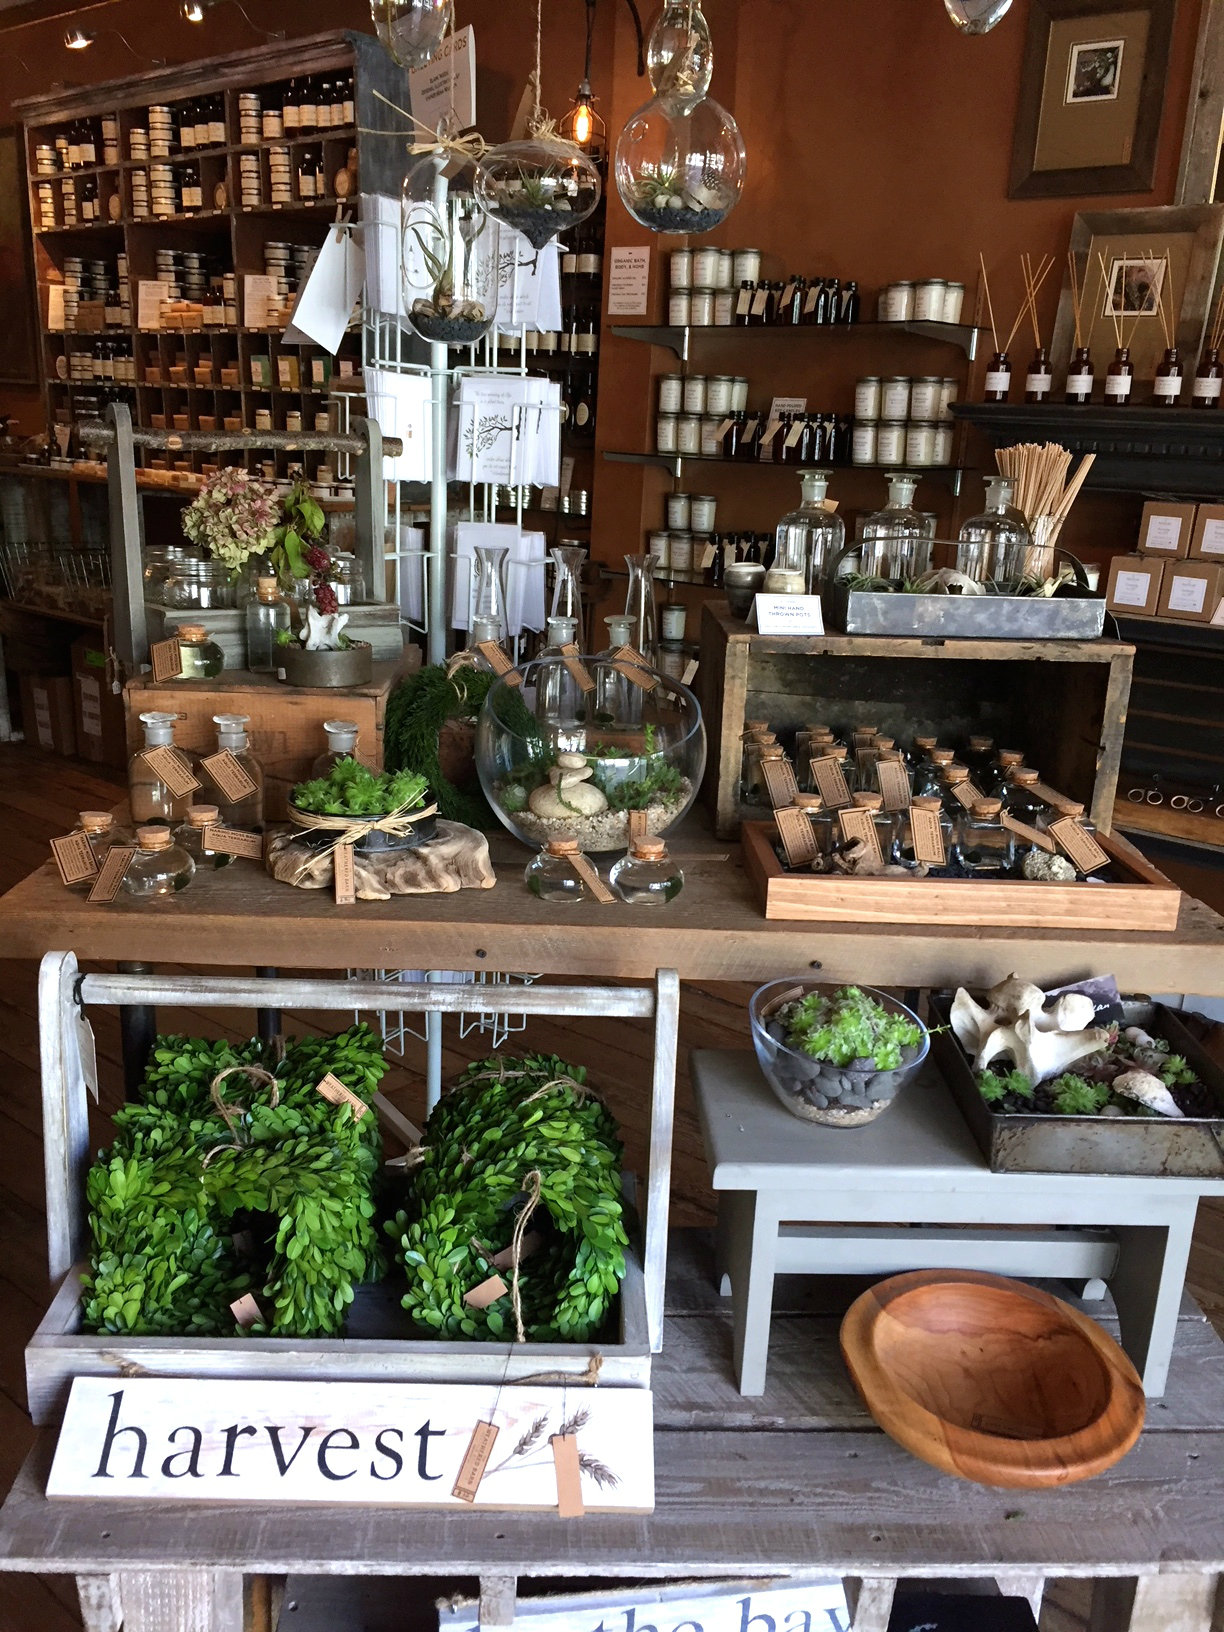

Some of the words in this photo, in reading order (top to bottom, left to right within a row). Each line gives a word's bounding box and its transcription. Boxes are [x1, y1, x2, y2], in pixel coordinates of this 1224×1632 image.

[444, 36, 467, 57] CRDS
[91, 1390, 447, 1481] harvest
[467, 1467, 477, 1485] BARN
